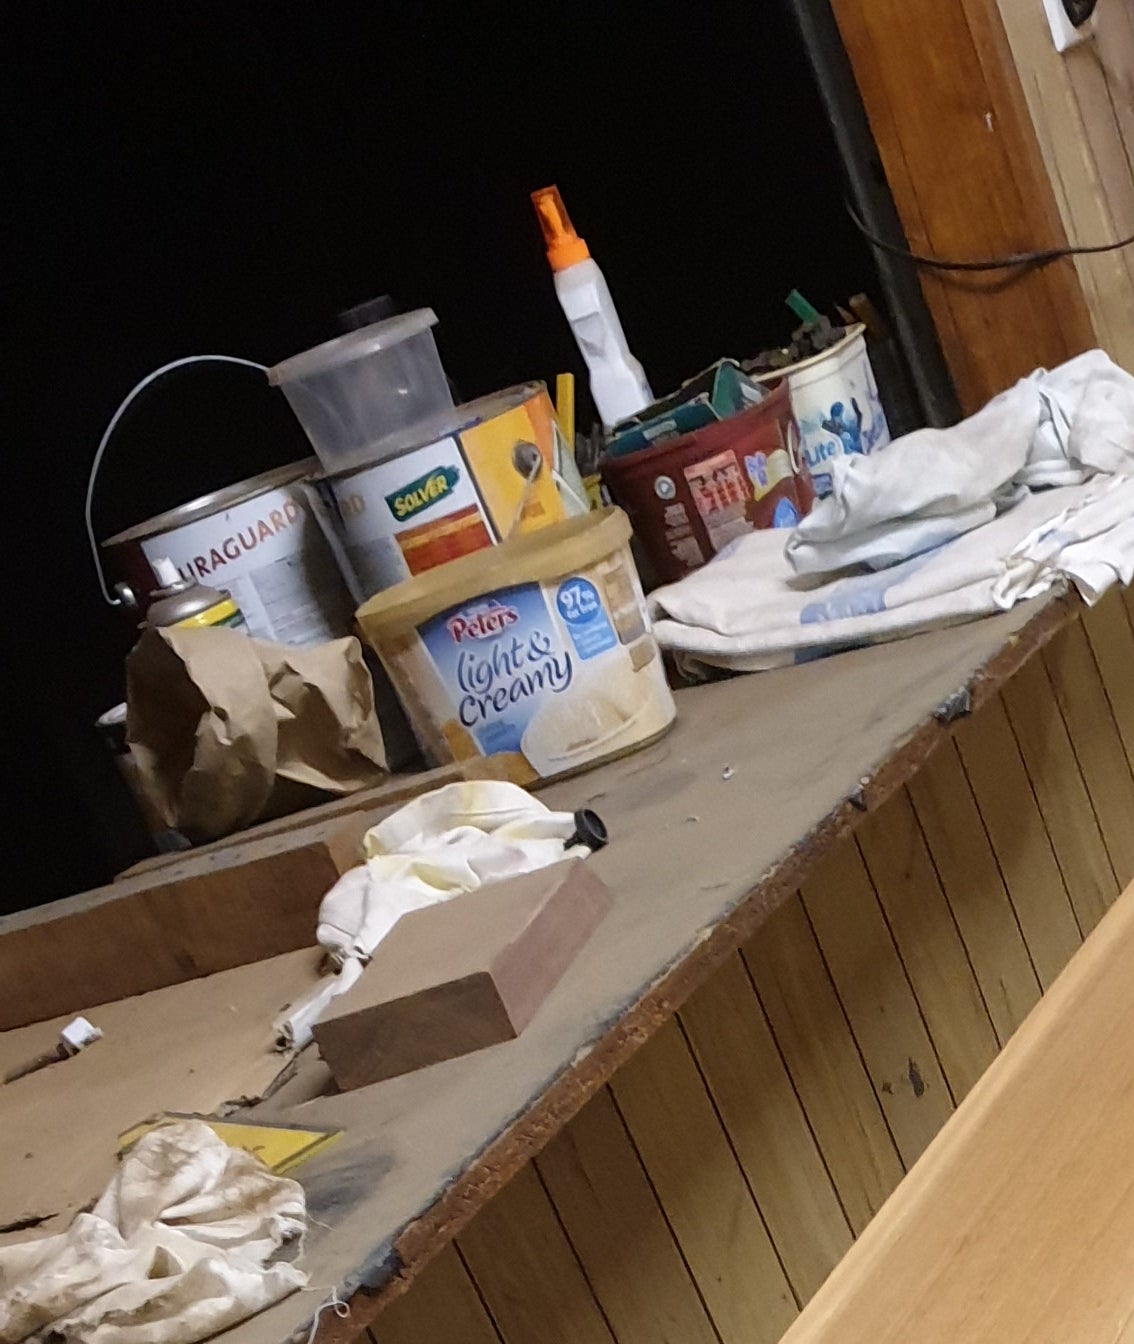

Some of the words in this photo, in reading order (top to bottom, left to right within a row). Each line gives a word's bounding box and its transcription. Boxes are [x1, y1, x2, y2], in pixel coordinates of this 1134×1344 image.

[394, 474, 448, 516] SOLVER
[177, 498, 299, 582] URAGUARD
[448, 606, 519, 643] Peters
[457, 637, 524, 694] light
[527, 631, 552, 662] &
